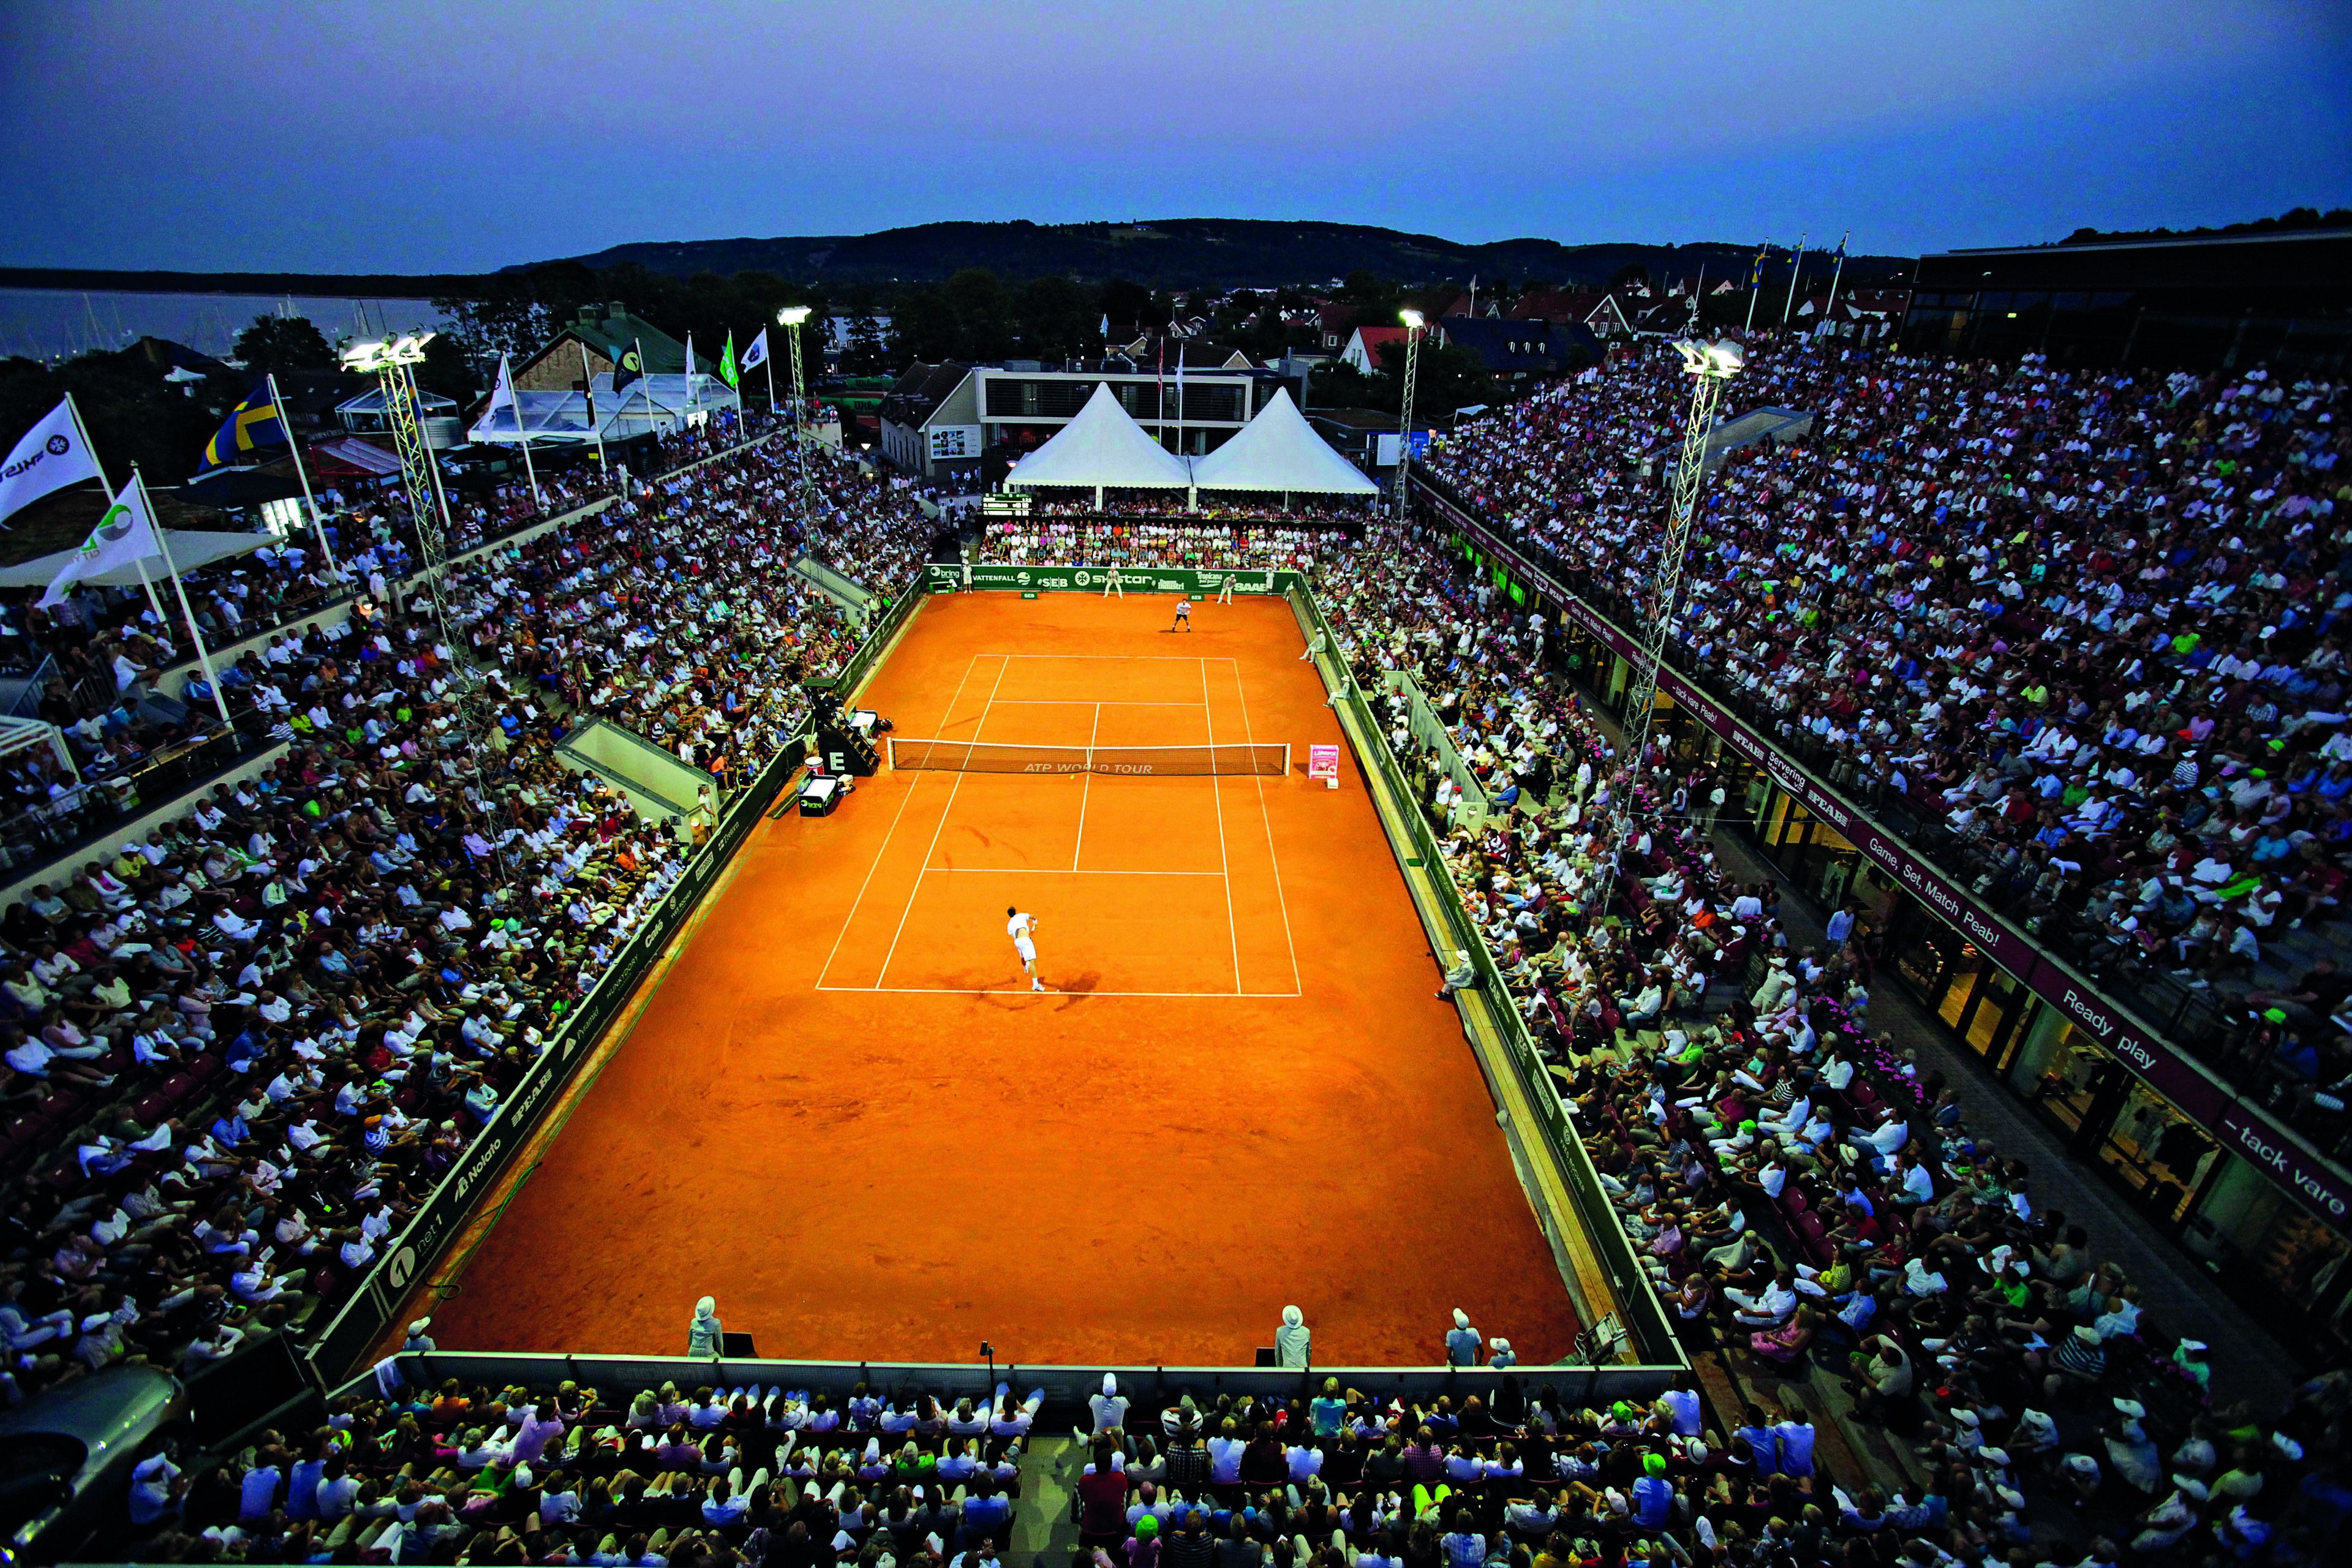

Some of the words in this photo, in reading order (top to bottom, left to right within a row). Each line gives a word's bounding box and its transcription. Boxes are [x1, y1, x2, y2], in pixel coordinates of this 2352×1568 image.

[1196, 571, 1223, 580] Tropicana
[1687, 696, 1699, 710] vare
[1700, 704, 1717, 724] Peab!
[1735, 731, 1762, 760] PEAB
[1024, 763, 1052, 772] ATP
[1115, 764, 1153, 774] TOUR
[1767, 761, 1777, 771] Mat
[1769, 752, 1806, 788] Servering
[1809, 791, 1845, 826] PEAB
[1869, 838, 1899, 870] Game,
[1903, 864, 1922, 890] Set,
[1924, 881, 1959, 916] Match
[1963, 911, 2000, 946] Peab!
[645, 919, 663, 948] Café
[606, 954, 639, 1000] HUNKYDORY
[577, 1006, 599, 1039] Pyramid
[2063, 989, 2113, 1036] Ready
[2117, 1036, 2157, 1069] play
[514, 1071, 551, 1123] PEAB
[468, 1139, 501, 1183] Nolato
[1560, 1136, 1569, 1158] YVES
[1569, 1158, 1585, 1193] ROCHER
[417, 1224, 437, 1253] net
